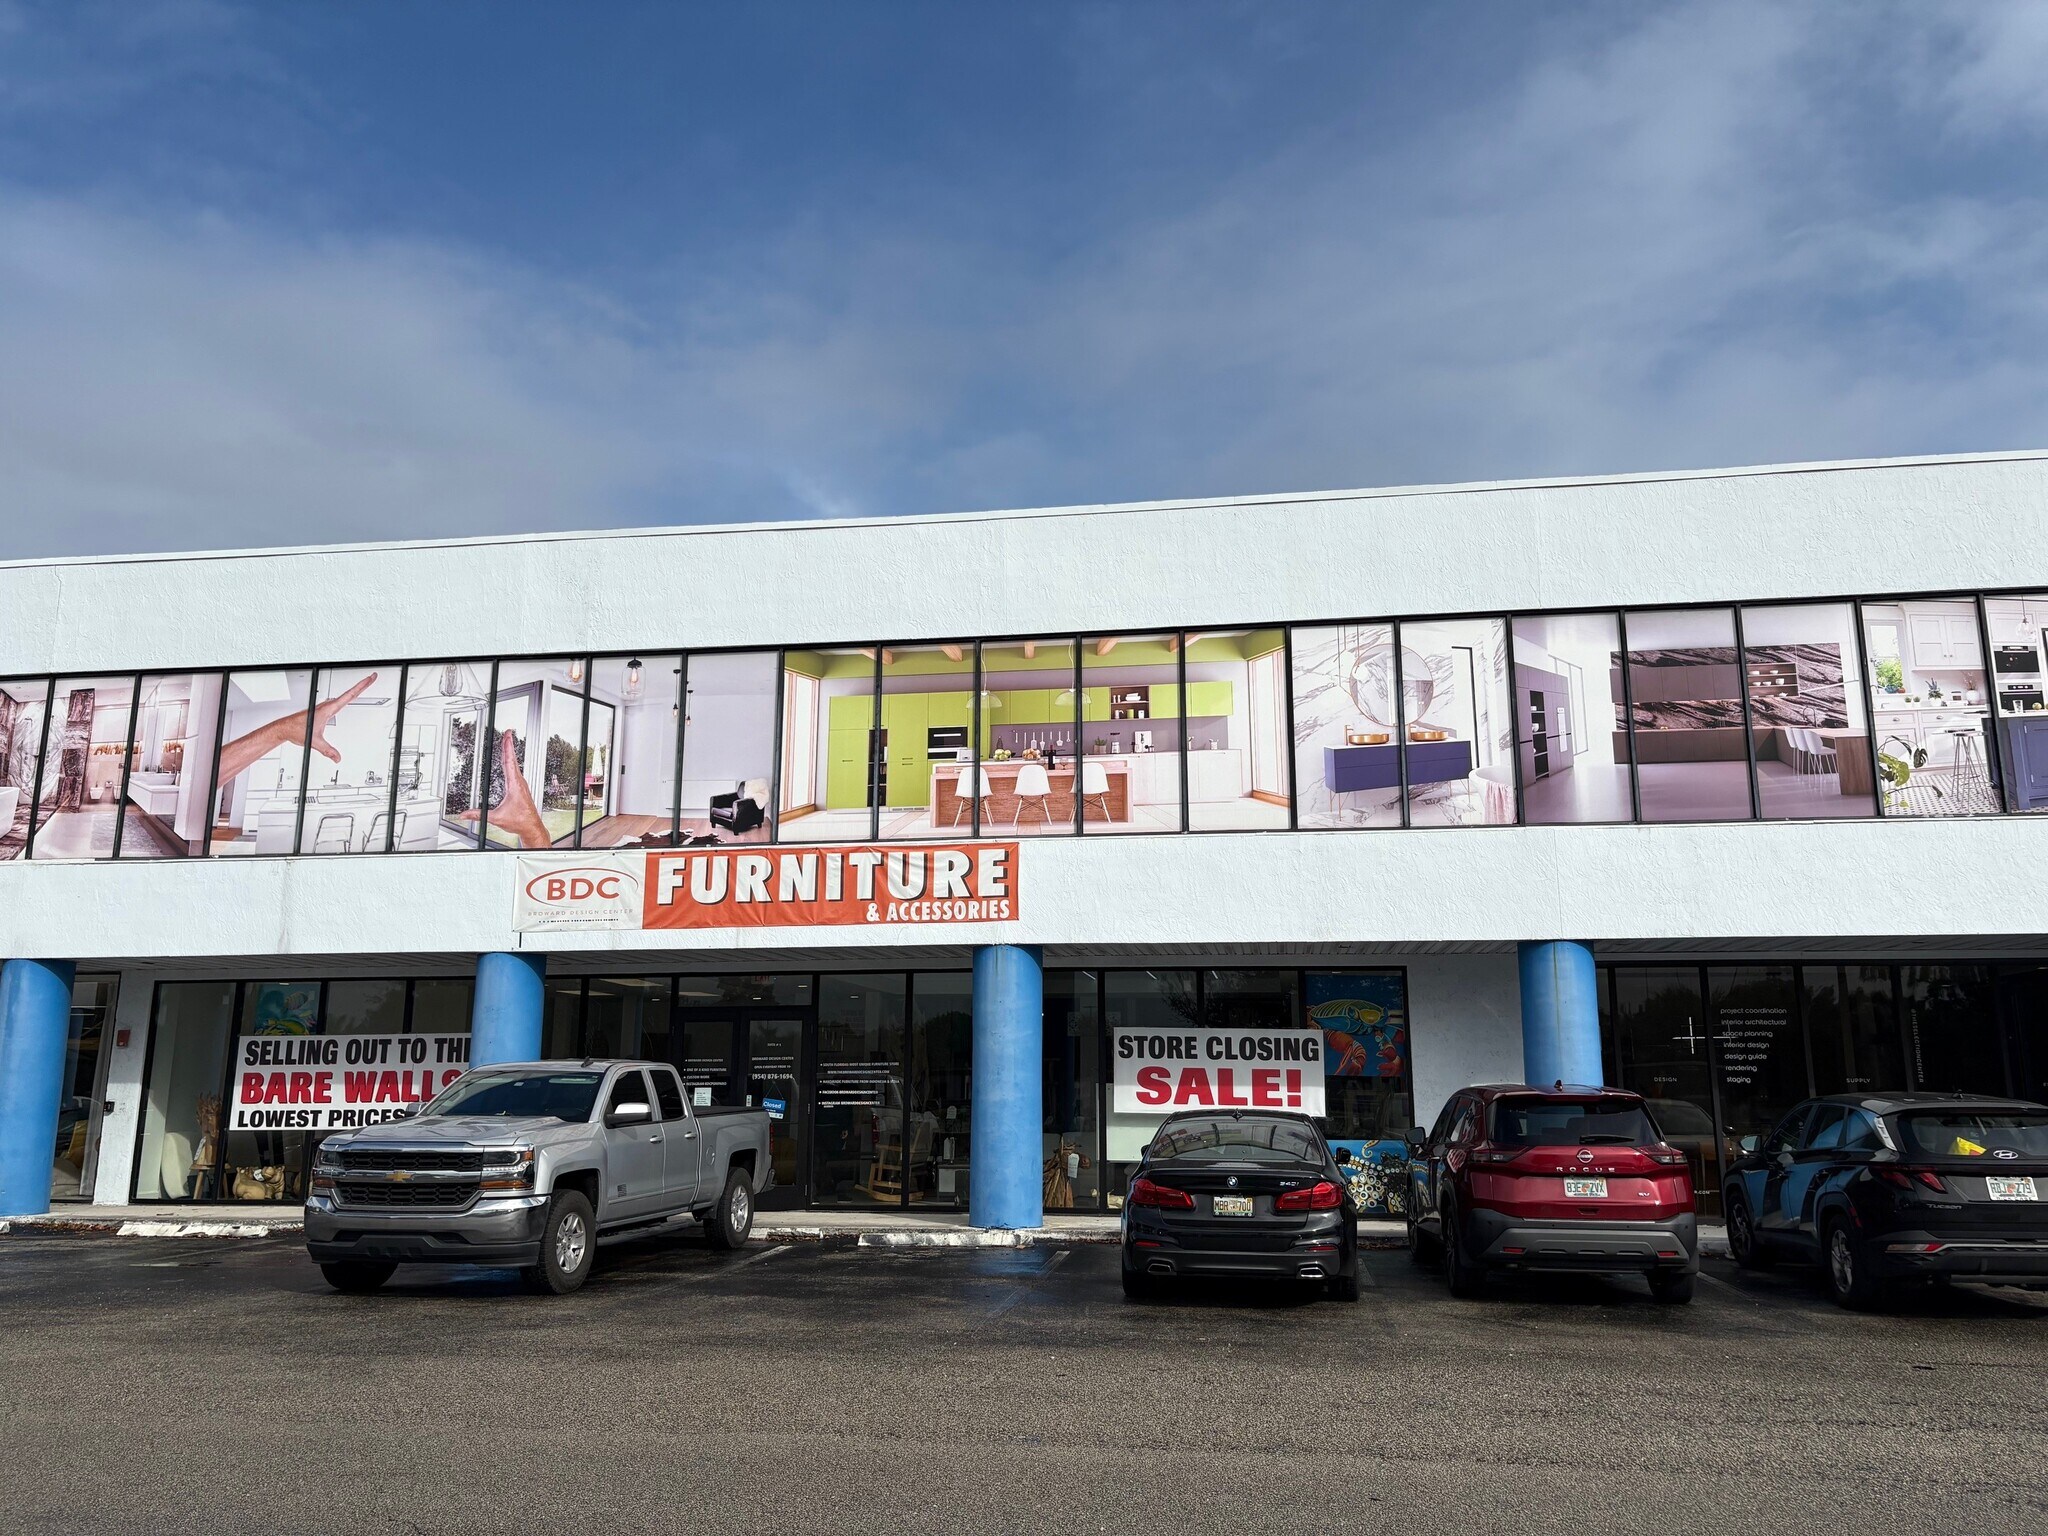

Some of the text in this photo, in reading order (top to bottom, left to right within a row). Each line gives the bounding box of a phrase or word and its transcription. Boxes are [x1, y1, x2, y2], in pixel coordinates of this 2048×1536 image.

[547, 877, 620, 900] BDC
[657, 849, 1007, 905] FURNITURE
[866, 899, 1010, 921] & ACCESSORIES
[245, 1039, 338, 1066] SELLING
[345, 1038, 392, 1064] OUT
[398, 1038, 427, 1064] TO
[1118, 1035, 1319, 1062] STORE CLOSING
[240, 1071, 333, 1105] BARE
[1136, 1066, 1301, 1107] SALE!
[1726, 1076, 1752, 1084] staging
[763, 1101, 782, 1109] Closed
[237, 1109, 406, 1128] LOWEST PRICES
[1589, 1182, 1605, 1193] ZVX
